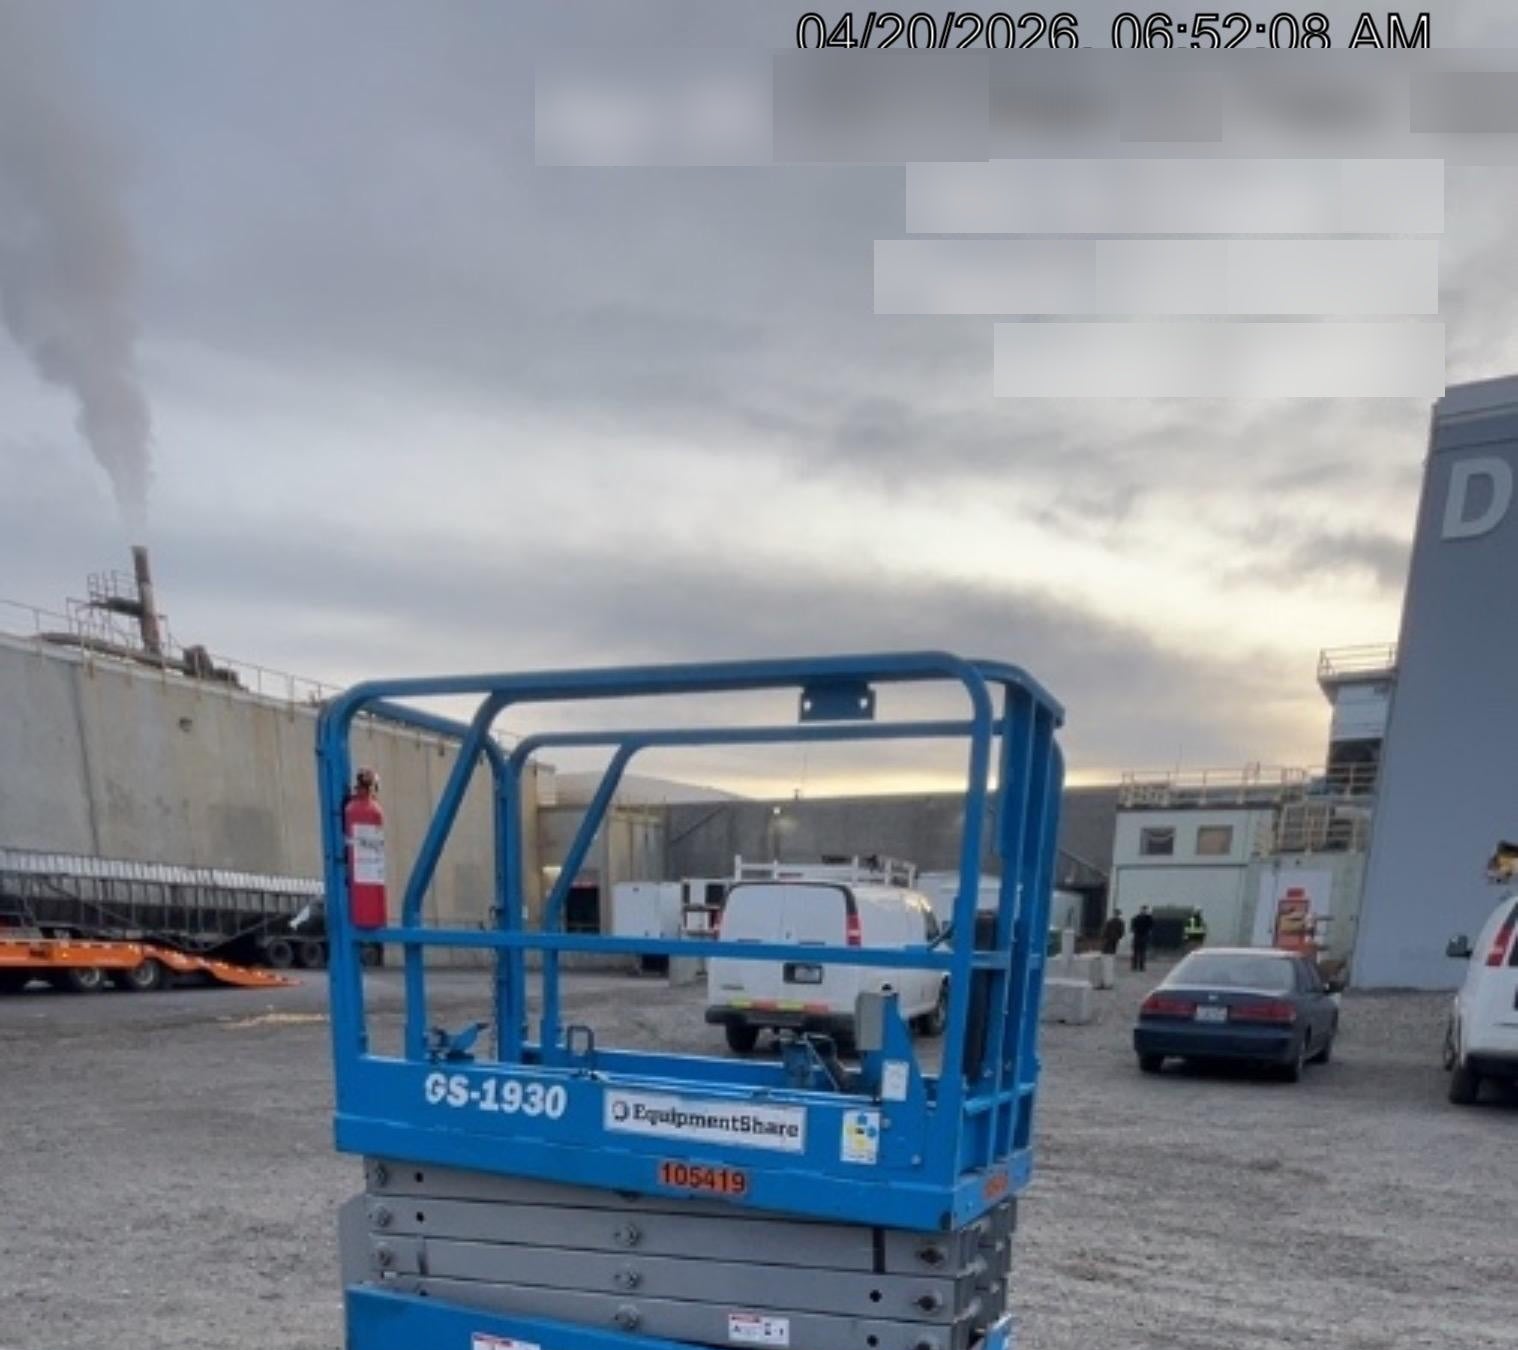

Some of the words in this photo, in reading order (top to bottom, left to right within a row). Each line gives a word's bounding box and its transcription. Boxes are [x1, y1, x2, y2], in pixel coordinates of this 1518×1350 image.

[1441, 457, 1513, 539] D
[425, 1072, 567, 1120] GS-1930
[632, 1103, 799, 1137] EquipmentShare
[661, 1162, 746, 1193] 105419
